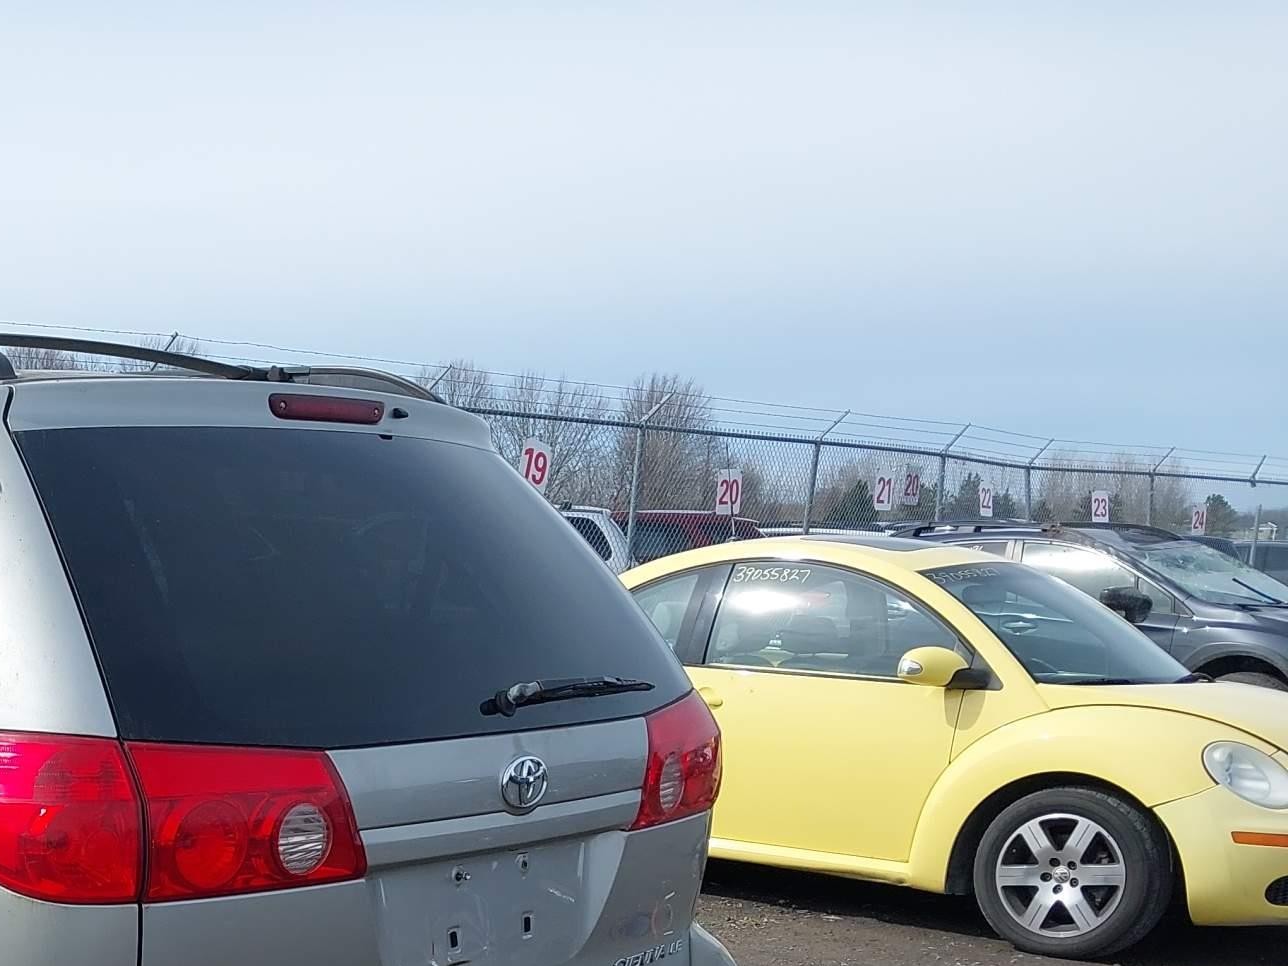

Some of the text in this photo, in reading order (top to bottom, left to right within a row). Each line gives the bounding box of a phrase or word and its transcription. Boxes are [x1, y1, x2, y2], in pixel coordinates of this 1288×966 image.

[523, 447, 549, 485] 19
[718, 478, 740, 506] 20
[876, 476, 893, 504] 21
[904, 473, 920, 497] 20
[981, 487, 992, 509] 22
[1093, 498, 1108, 518] 23
[1192, 511, 1205, 529] 24
[733, 566, 811, 584] 39055827
